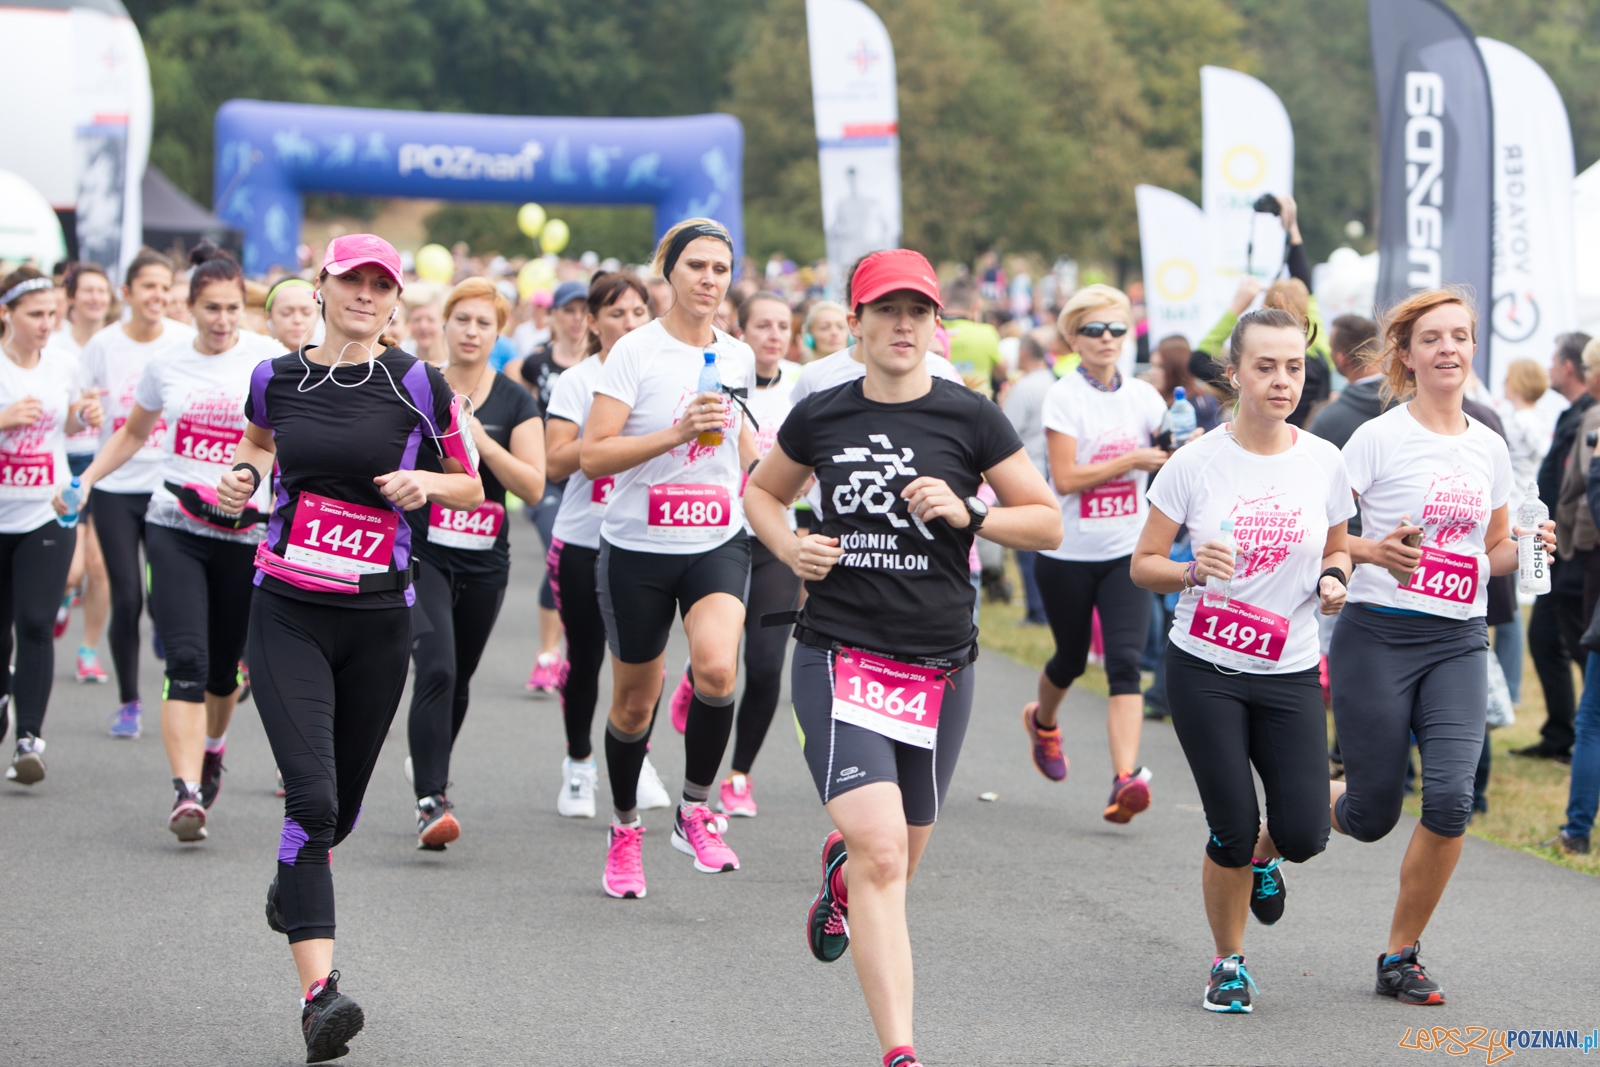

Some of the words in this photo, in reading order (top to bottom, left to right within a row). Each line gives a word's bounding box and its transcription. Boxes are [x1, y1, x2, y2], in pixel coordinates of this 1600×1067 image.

[181, 435, 237, 464] 1665
[2, 465, 49, 486] 1671
[1088, 494, 1135, 518] 1514
[1434, 491, 1482, 507] zawsze
[367, 515, 382, 524] 2016
[439, 508, 495, 535] 1844
[659, 501, 722, 524] 1480
[1234, 515, 1297, 529] zawsze
[303, 519, 385, 558] 1447
[840, 530, 898, 550] KÓRNIK
[1411, 566, 1473, 600] 1490
[1202, 615, 1272, 656] 1491
[909, 673, 926, 682] 2016
[848, 675, 927, 722] 1864
